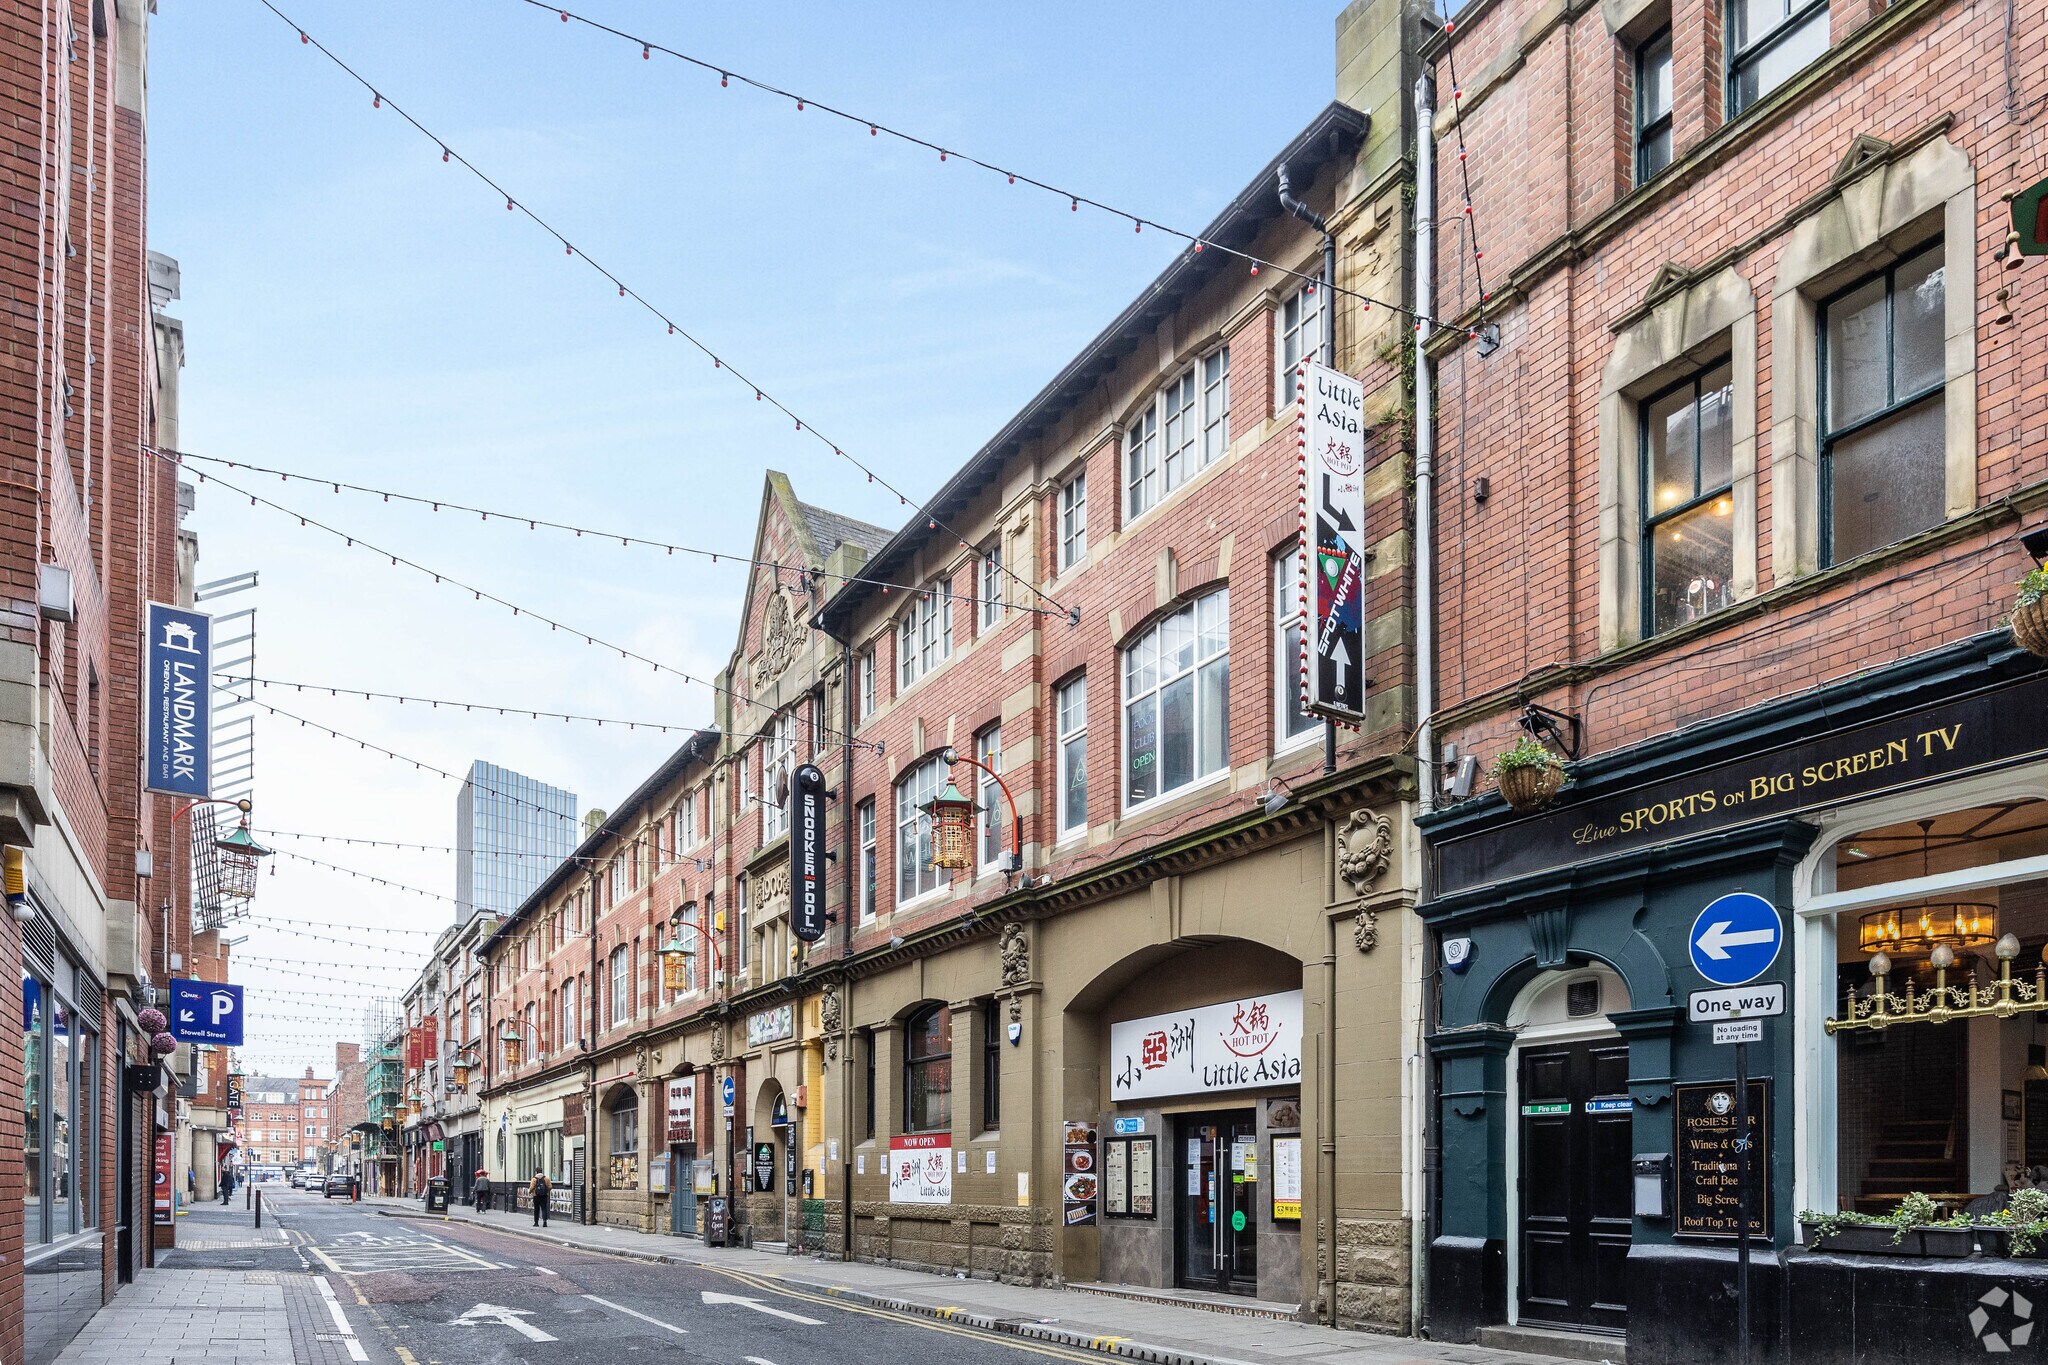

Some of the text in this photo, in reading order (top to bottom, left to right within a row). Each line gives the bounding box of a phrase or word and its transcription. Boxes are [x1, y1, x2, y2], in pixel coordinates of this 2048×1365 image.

[1318, 377, 1360, 410] Little
[1318, 403, 1358, 434] Asia
[1326, 456, 1352, 472] HOT POT
[173, 661, 196, 782] LANDMARK
[1133, 750, 1156, 769] OPEN
[1572, 822, 1618, 846] Live
[1619, 790, 1716, 834] SPORTS
[1749, 772, 1795, 801] BIG
[1802, 738, 1908, 788] SCREEN
[1916, 723, 1962, 756] TV
[804, 794, 815, 876] SNOOKER
[762, 872, 783, 901] 1908
[805, 881, 816, 927] POOL
[1696, 999, 1732, 1014] One
[1739, 996, 1776, 1010] way
[180, 1028, 206, 1036] Stowell
[1730, 1025, 1758, 1033] loading
[1232, 1032, 1270, 1048] HOT POT
[1203, 1053, 1301, 1087] Little Asia
[229, 1080, 239, 1106] GATE
[1687, 1116, 1756, 1126] ROSIE'S BR
[904, 1137, 936, 1147] NOW OPEN
[1690, 1140, 1718, 1150] Wines
[1720, 1140, 1728, 1149] &
[1696, 1175, 1718, 1186] Craft
[920, 1186, 950, 1197] Little Asia
[1697, 1194, 1738, 1206] Big Scre
[712, 1222, 724, 1230] Open
[1684, 1216, 1760, 1228] Roof Top Tece
